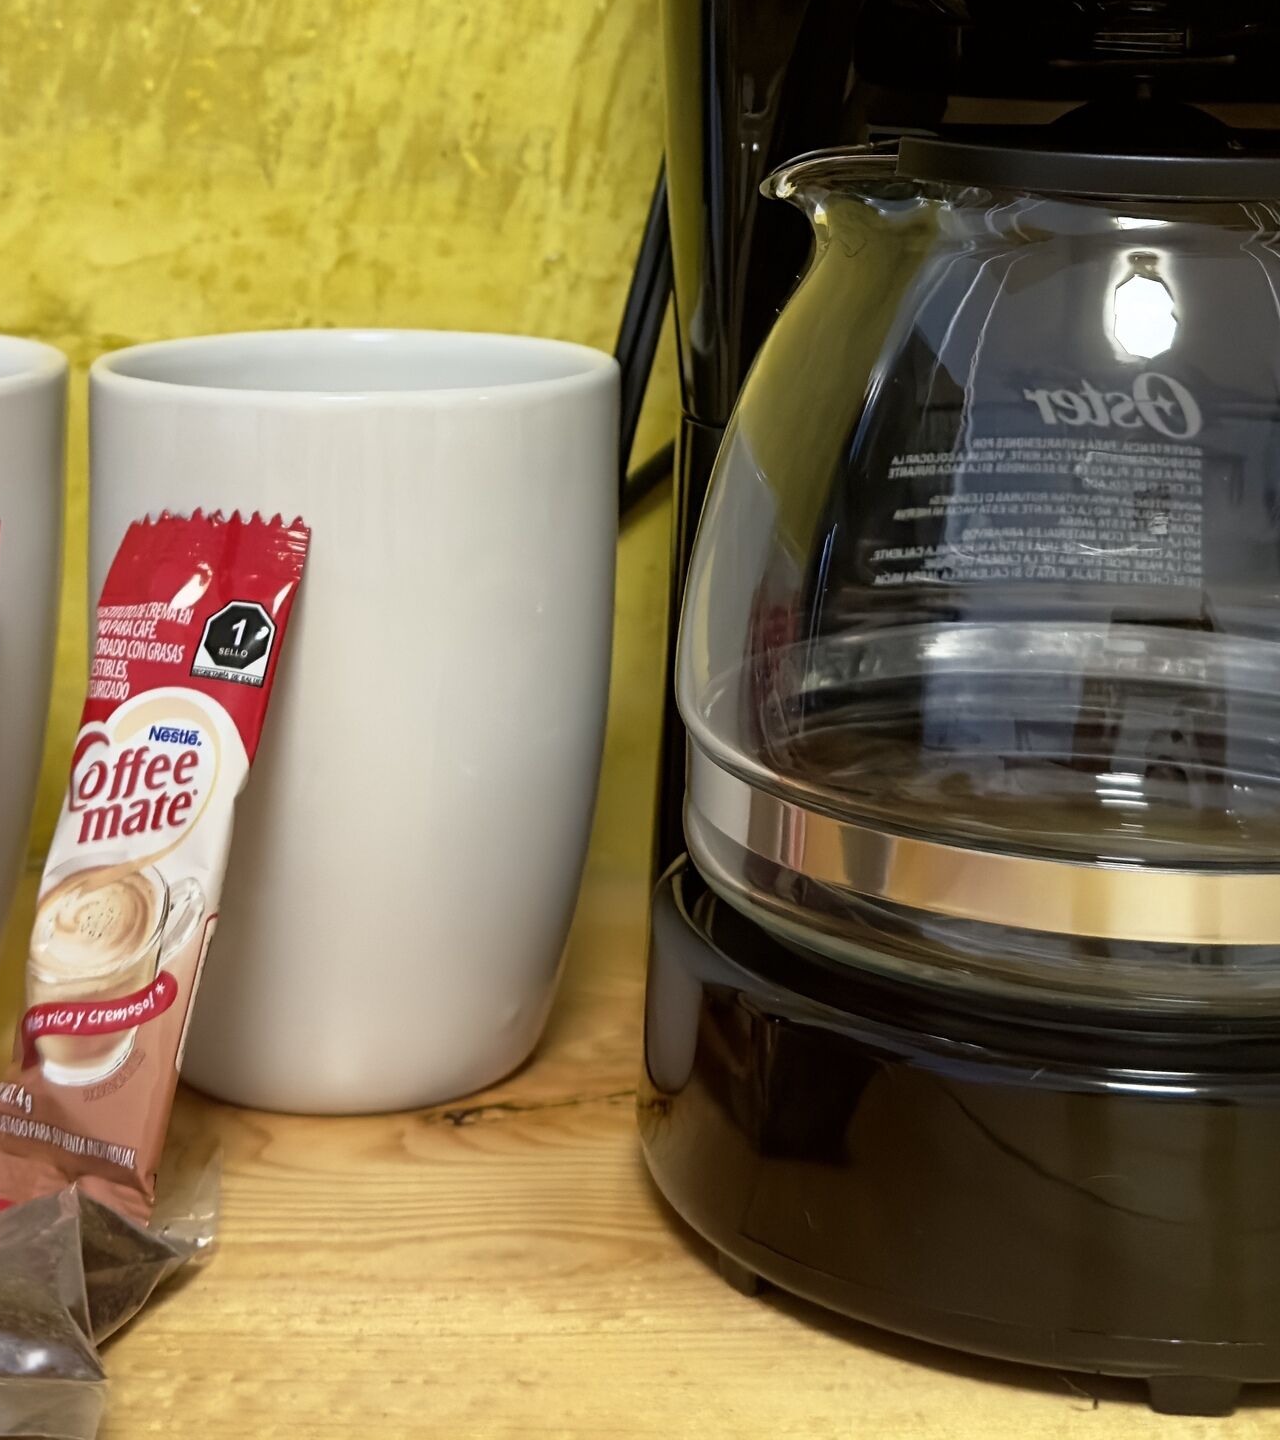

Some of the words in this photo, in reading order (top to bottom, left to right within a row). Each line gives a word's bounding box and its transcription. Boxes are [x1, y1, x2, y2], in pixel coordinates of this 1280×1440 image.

[145, 601, 178, 622] CREMA
[176, 607, 195, 625] EN
[108, 620, 133, 637] PARA
[232, 618, 247, 647] 1
[97, 638, 127, 657] ORADO
[127, 639, 148, 660] CON
[147, 641, 186, 663] GRASAS
[218, 647, 249, 659] SELLO
[92, 659, 129, 681] STIBLES,
[89, 680, 131, 700] URIZADO
[69, 731, 200, 812] Coffee
[77, 791, 193, 844] mate
[46, 1011, 73, 1028] rico
[72, 1010, 85, 1031] y
[16, 1086, 25, 1107] 4
[25, 1093, 33, 1114] g
